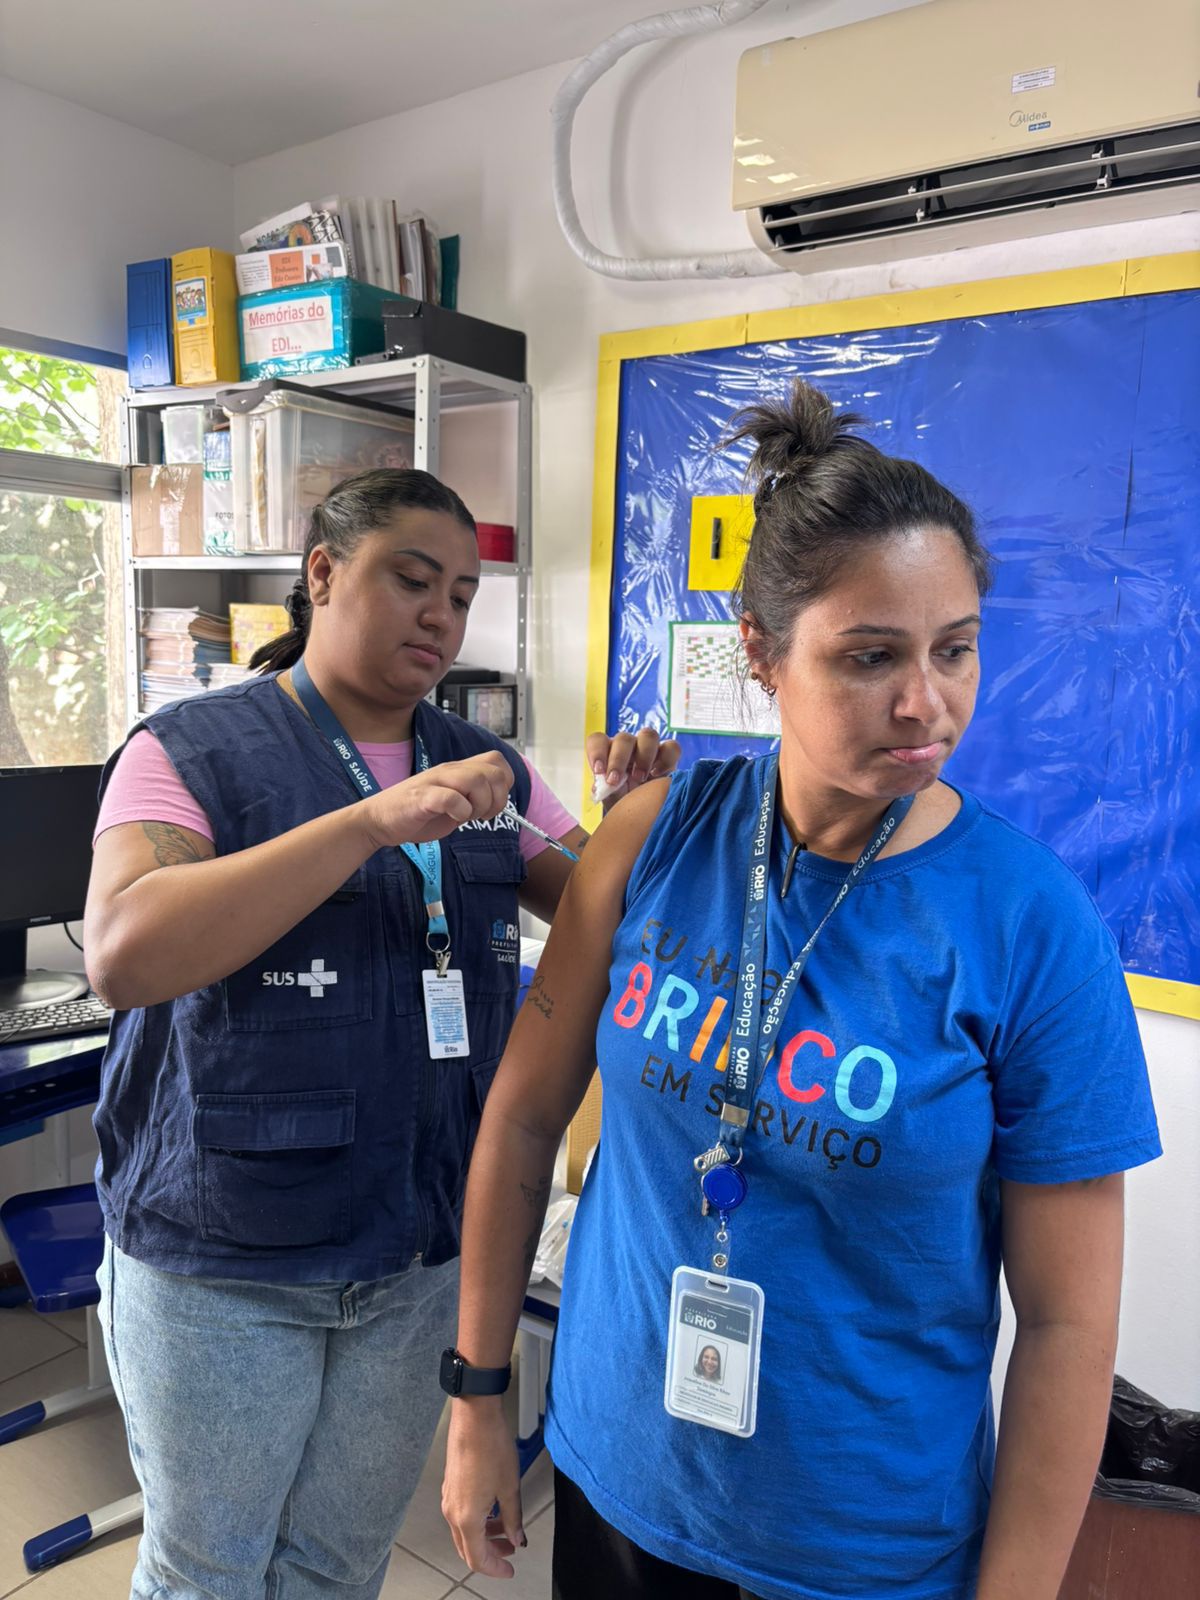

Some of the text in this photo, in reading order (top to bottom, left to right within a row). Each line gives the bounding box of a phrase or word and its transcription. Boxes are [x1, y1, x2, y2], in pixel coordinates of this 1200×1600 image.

[249, 304, 305, 327] Memórias
[271, 336, 302, 353] EDI...
[337, 743, 352, 761] RIO
[348, 761, 373, 793] SAÚDE
[753, 791, 772, 888] RIO Educação
[852, 817, 896, 877] Educação
[640, 917, 688, 964] EU
[261, 971, 296, 987] SUS
[763, 961, 801, 1035] Educação
[735, 962, 756, 1077] RIO Educação
[640, 1053, 883, 1171] EM SRVIÇO
[694, 1316, 718, 1331] RIO
